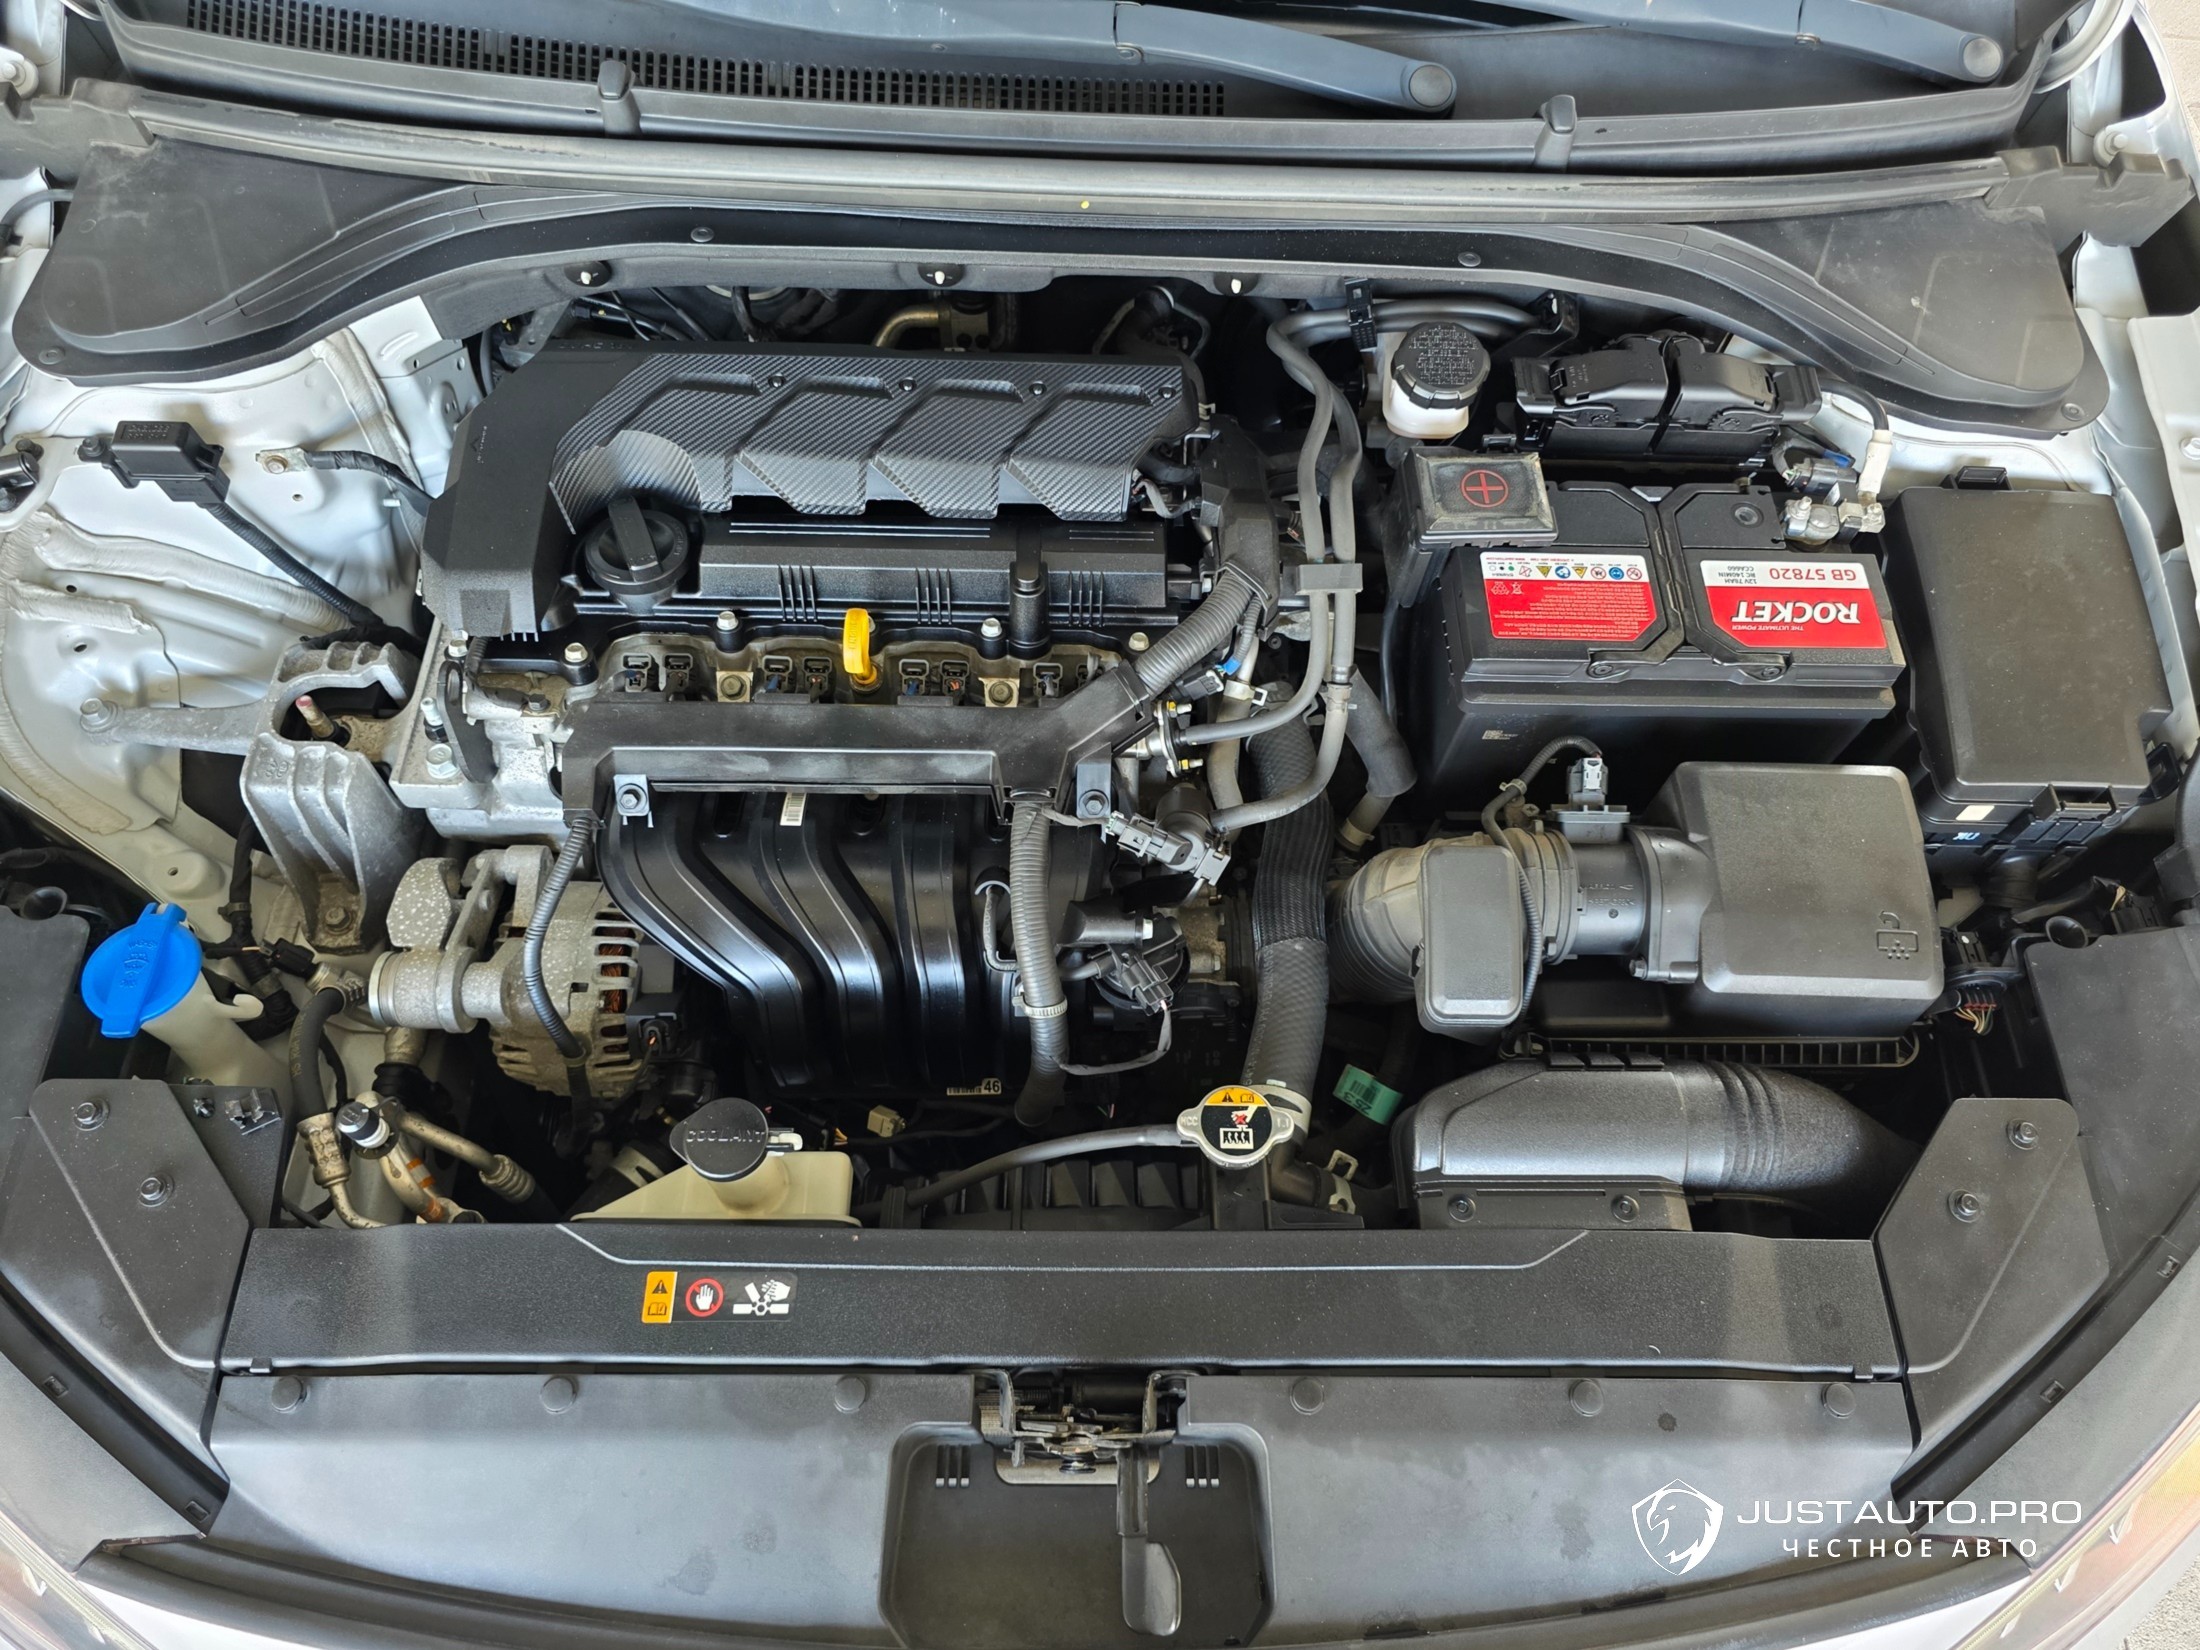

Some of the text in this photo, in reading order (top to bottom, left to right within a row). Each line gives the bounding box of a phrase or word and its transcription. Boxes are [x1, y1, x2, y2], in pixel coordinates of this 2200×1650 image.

[1769, 567, 1857, 581] GB 57820
[1730, 601, 1861, 624] ROCKET
[984, 1080, 1000, 1093] 46
[1180, 1116, 1199, 1127] HCC
[686, 1129, 765, 1142] COOLANT
